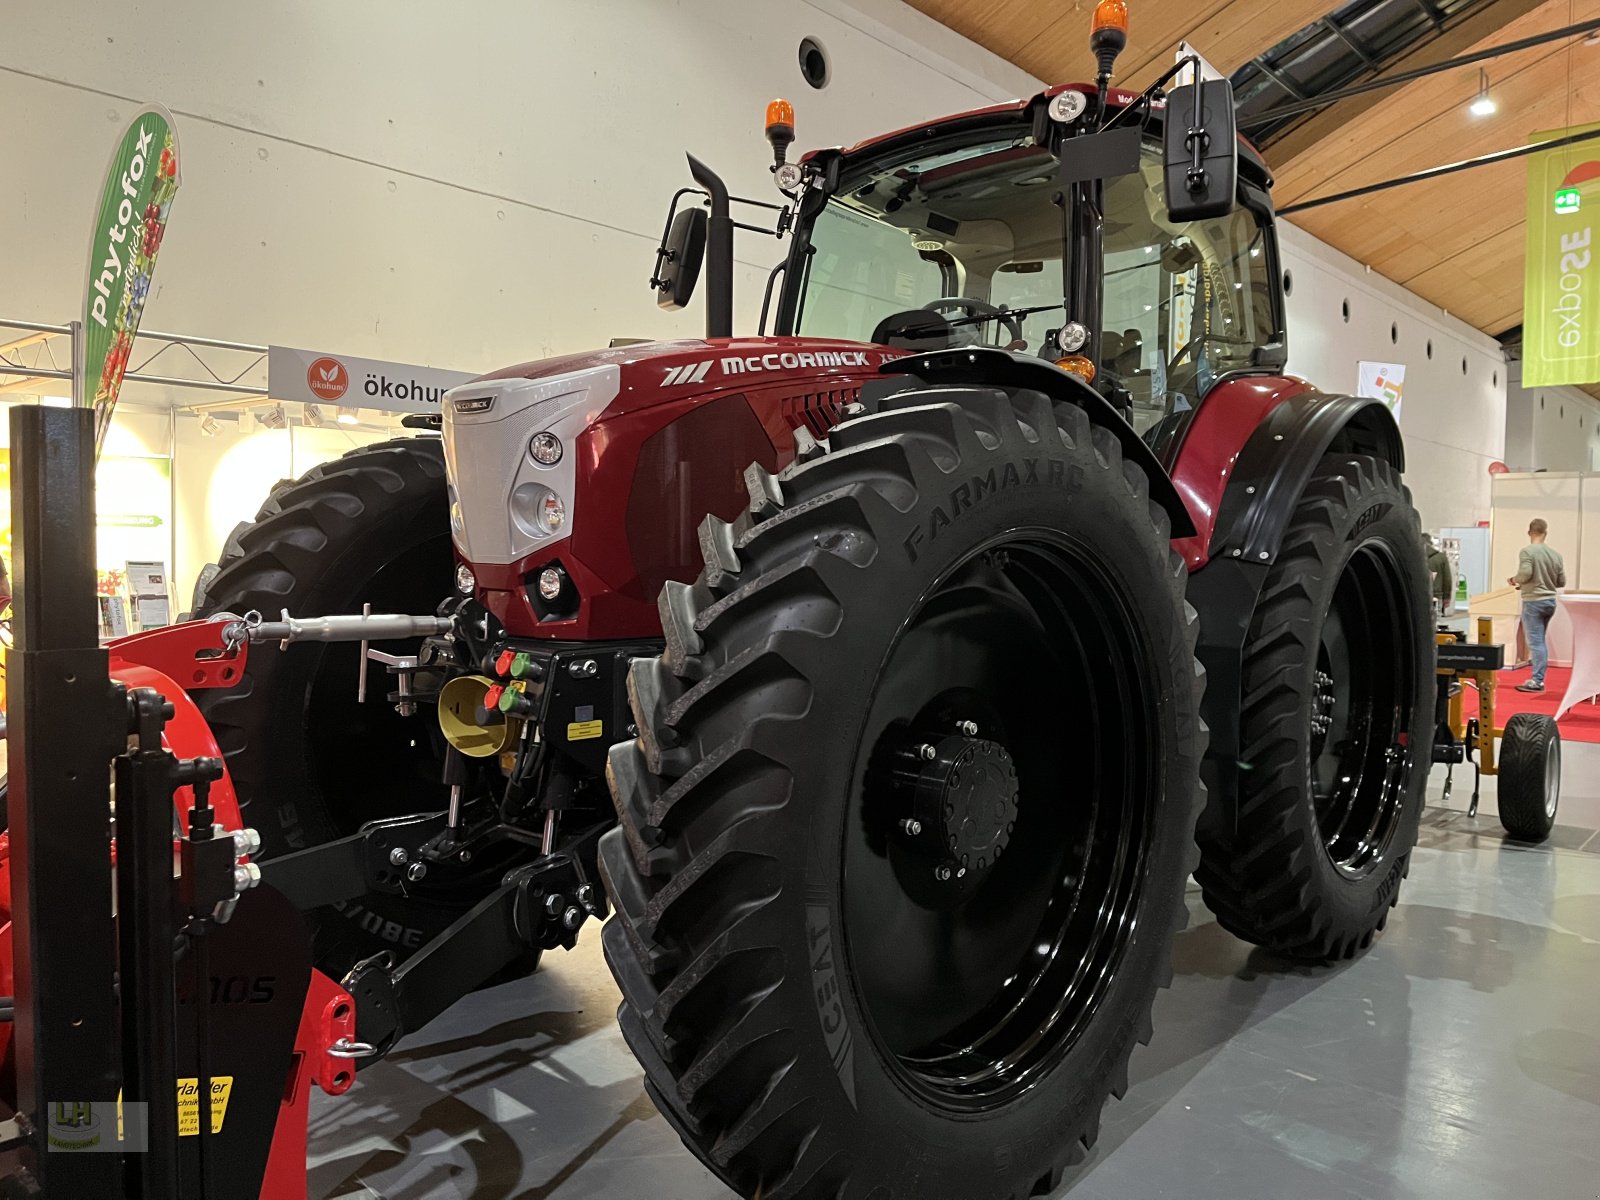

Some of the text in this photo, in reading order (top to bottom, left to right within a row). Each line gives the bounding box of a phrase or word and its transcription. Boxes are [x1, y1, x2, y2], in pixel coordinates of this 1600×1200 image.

[91, 122, 153, 328] phytofox
[312, 380, 344, 391] ökohum
[720, 351, 870, 375] McCORMICK
[902, 457, 1040, 565] FARMAX
[810, 923, 842, 1035] CEAT
